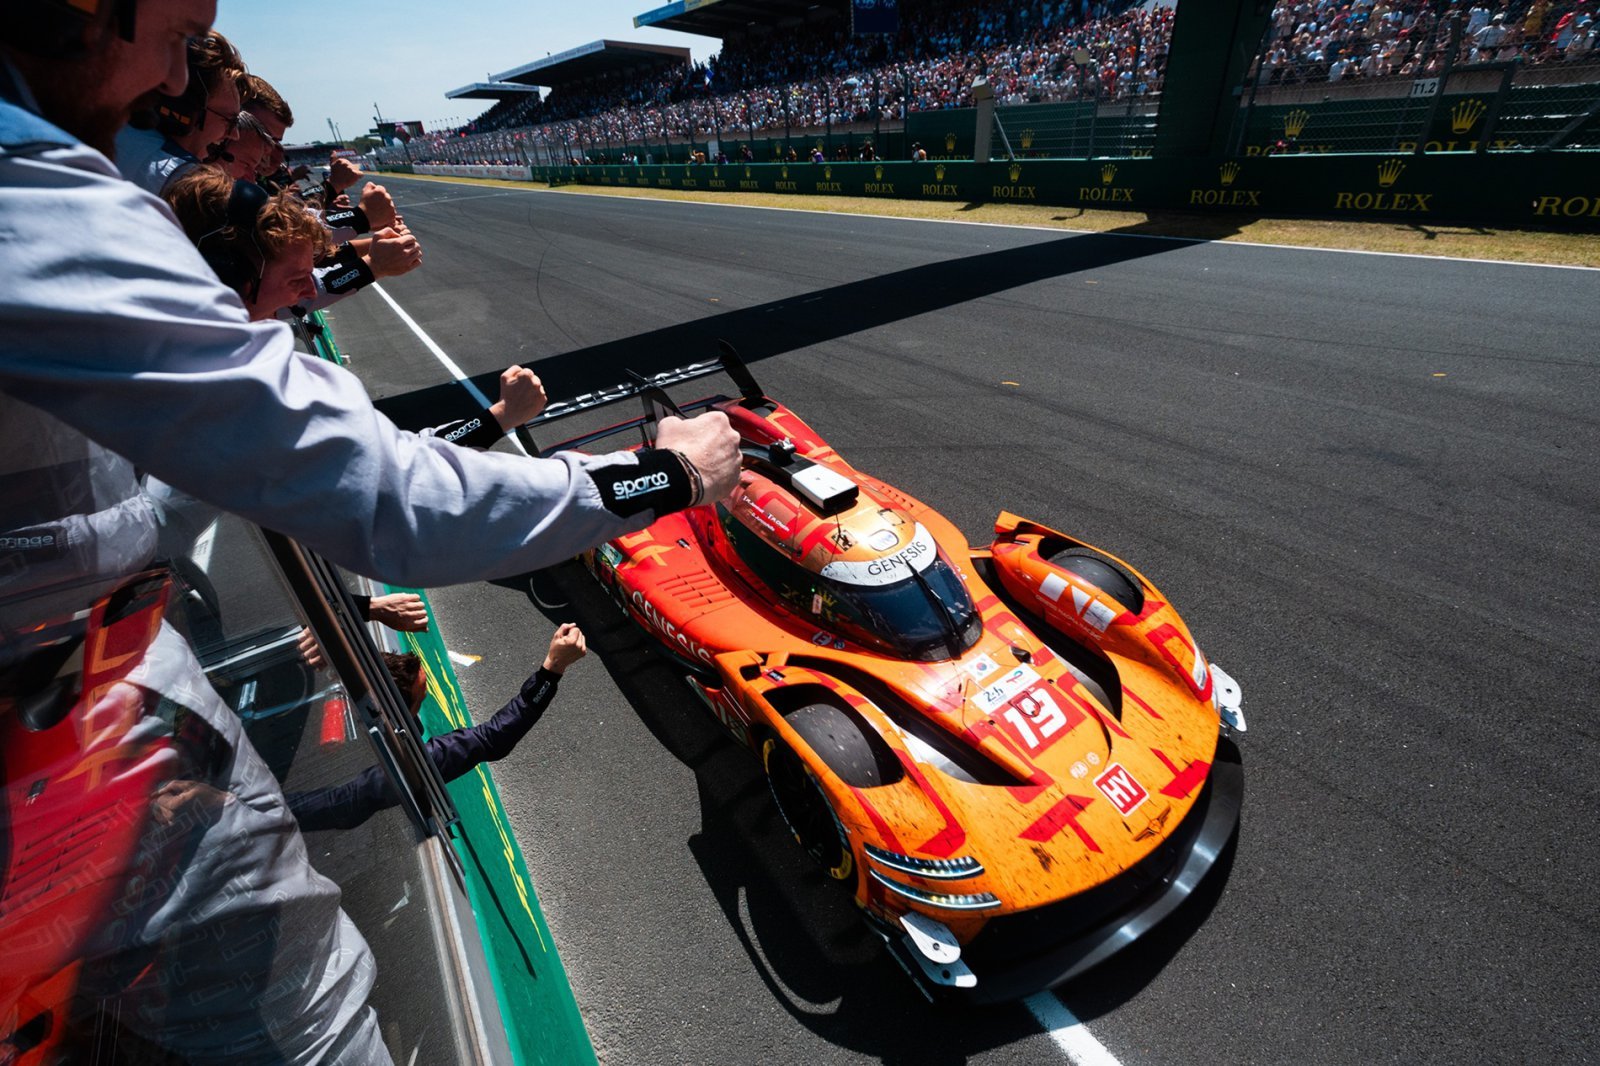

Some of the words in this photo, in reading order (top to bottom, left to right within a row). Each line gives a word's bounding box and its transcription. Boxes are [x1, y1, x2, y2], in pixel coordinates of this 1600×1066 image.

[1412, 82, 1436, 96] T1.2
[816, 182, 842, 192] ROLEX
[865, 183, 895, 194] ROLEX
[922, 185, 958, 196] ROLEX
[992, 186, 1036, 199] ROLEX
[1079, 187, 1134, 202] ROLEX
[1190, 189, 1261, 206] ROLEX
[1335, 192, 1433, 212] ROLEX
[444, 418, 483, 442] sparco
[613, 471, 670, 500] sparco
[868, 541, 927, 576] GENESIS
[1003, 688, 1067, 749] 19
[1101, 769, 1138, 809] HY
